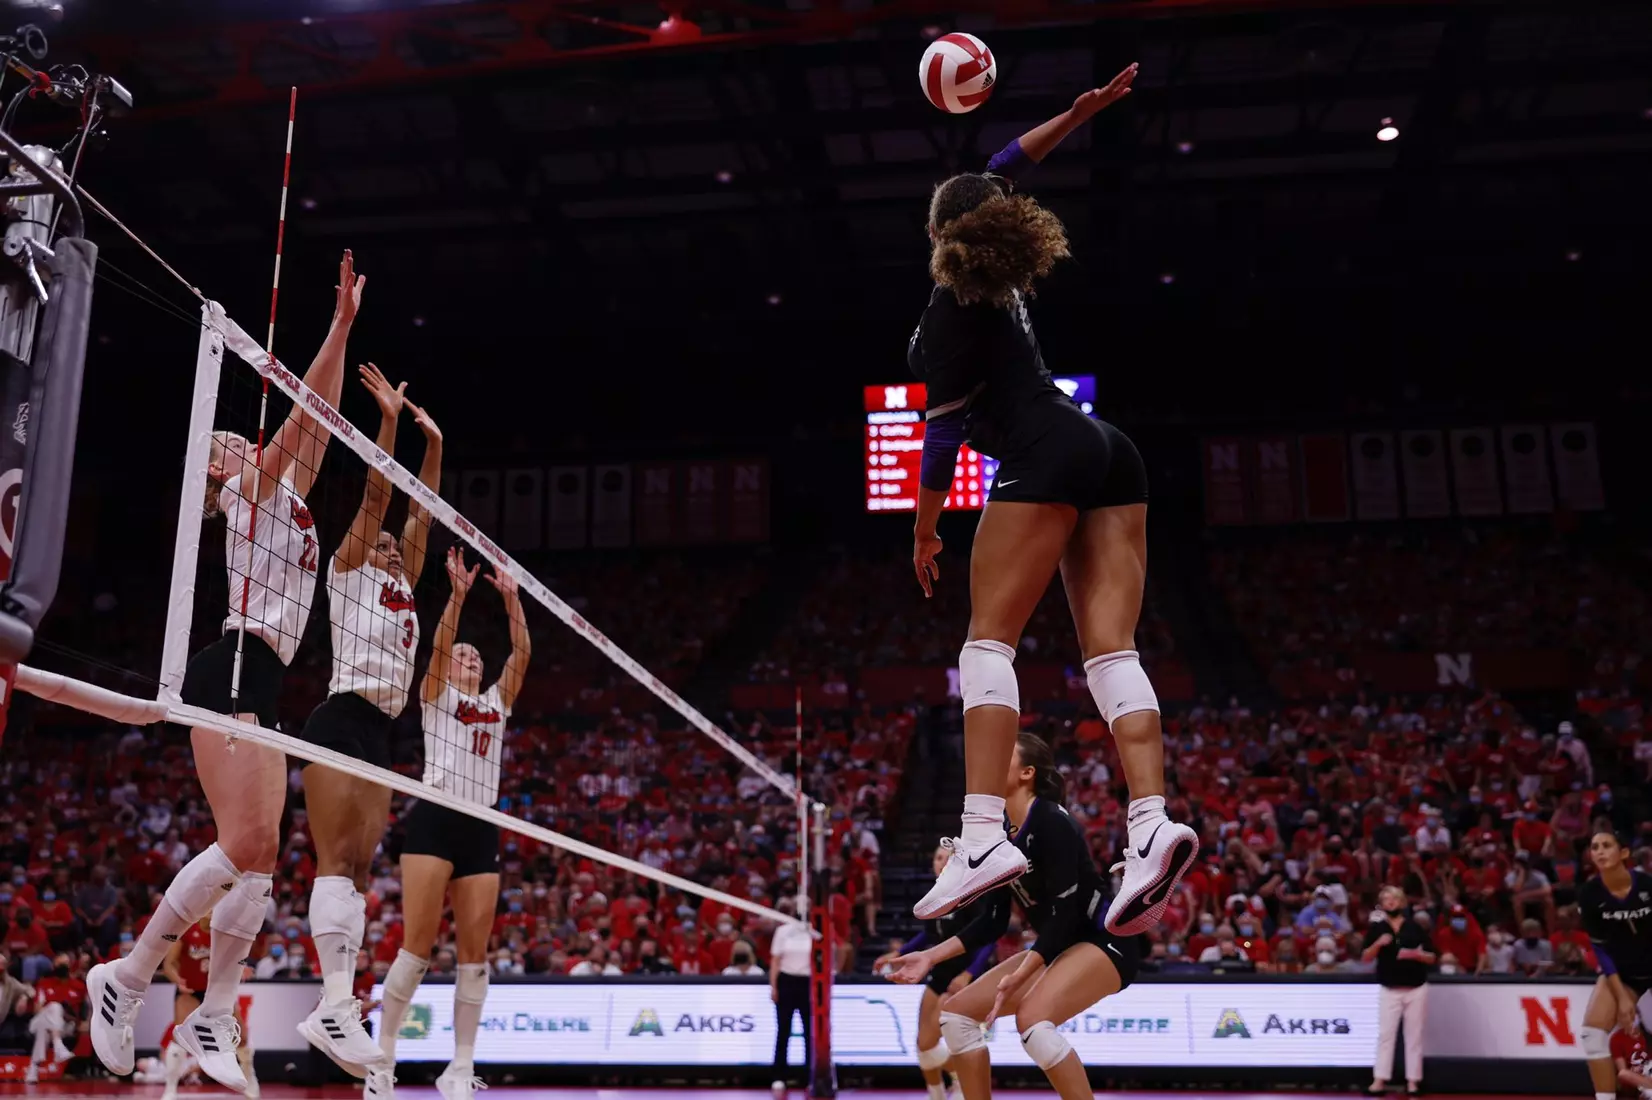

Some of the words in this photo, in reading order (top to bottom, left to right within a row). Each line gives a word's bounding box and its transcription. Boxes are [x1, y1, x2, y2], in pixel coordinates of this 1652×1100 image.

[402, 618, 414, 649] 3
[1433, 651, 1473, 688] N
[472, 729, 491, 757] 10
[1519, 995, 1576, 1047] N
